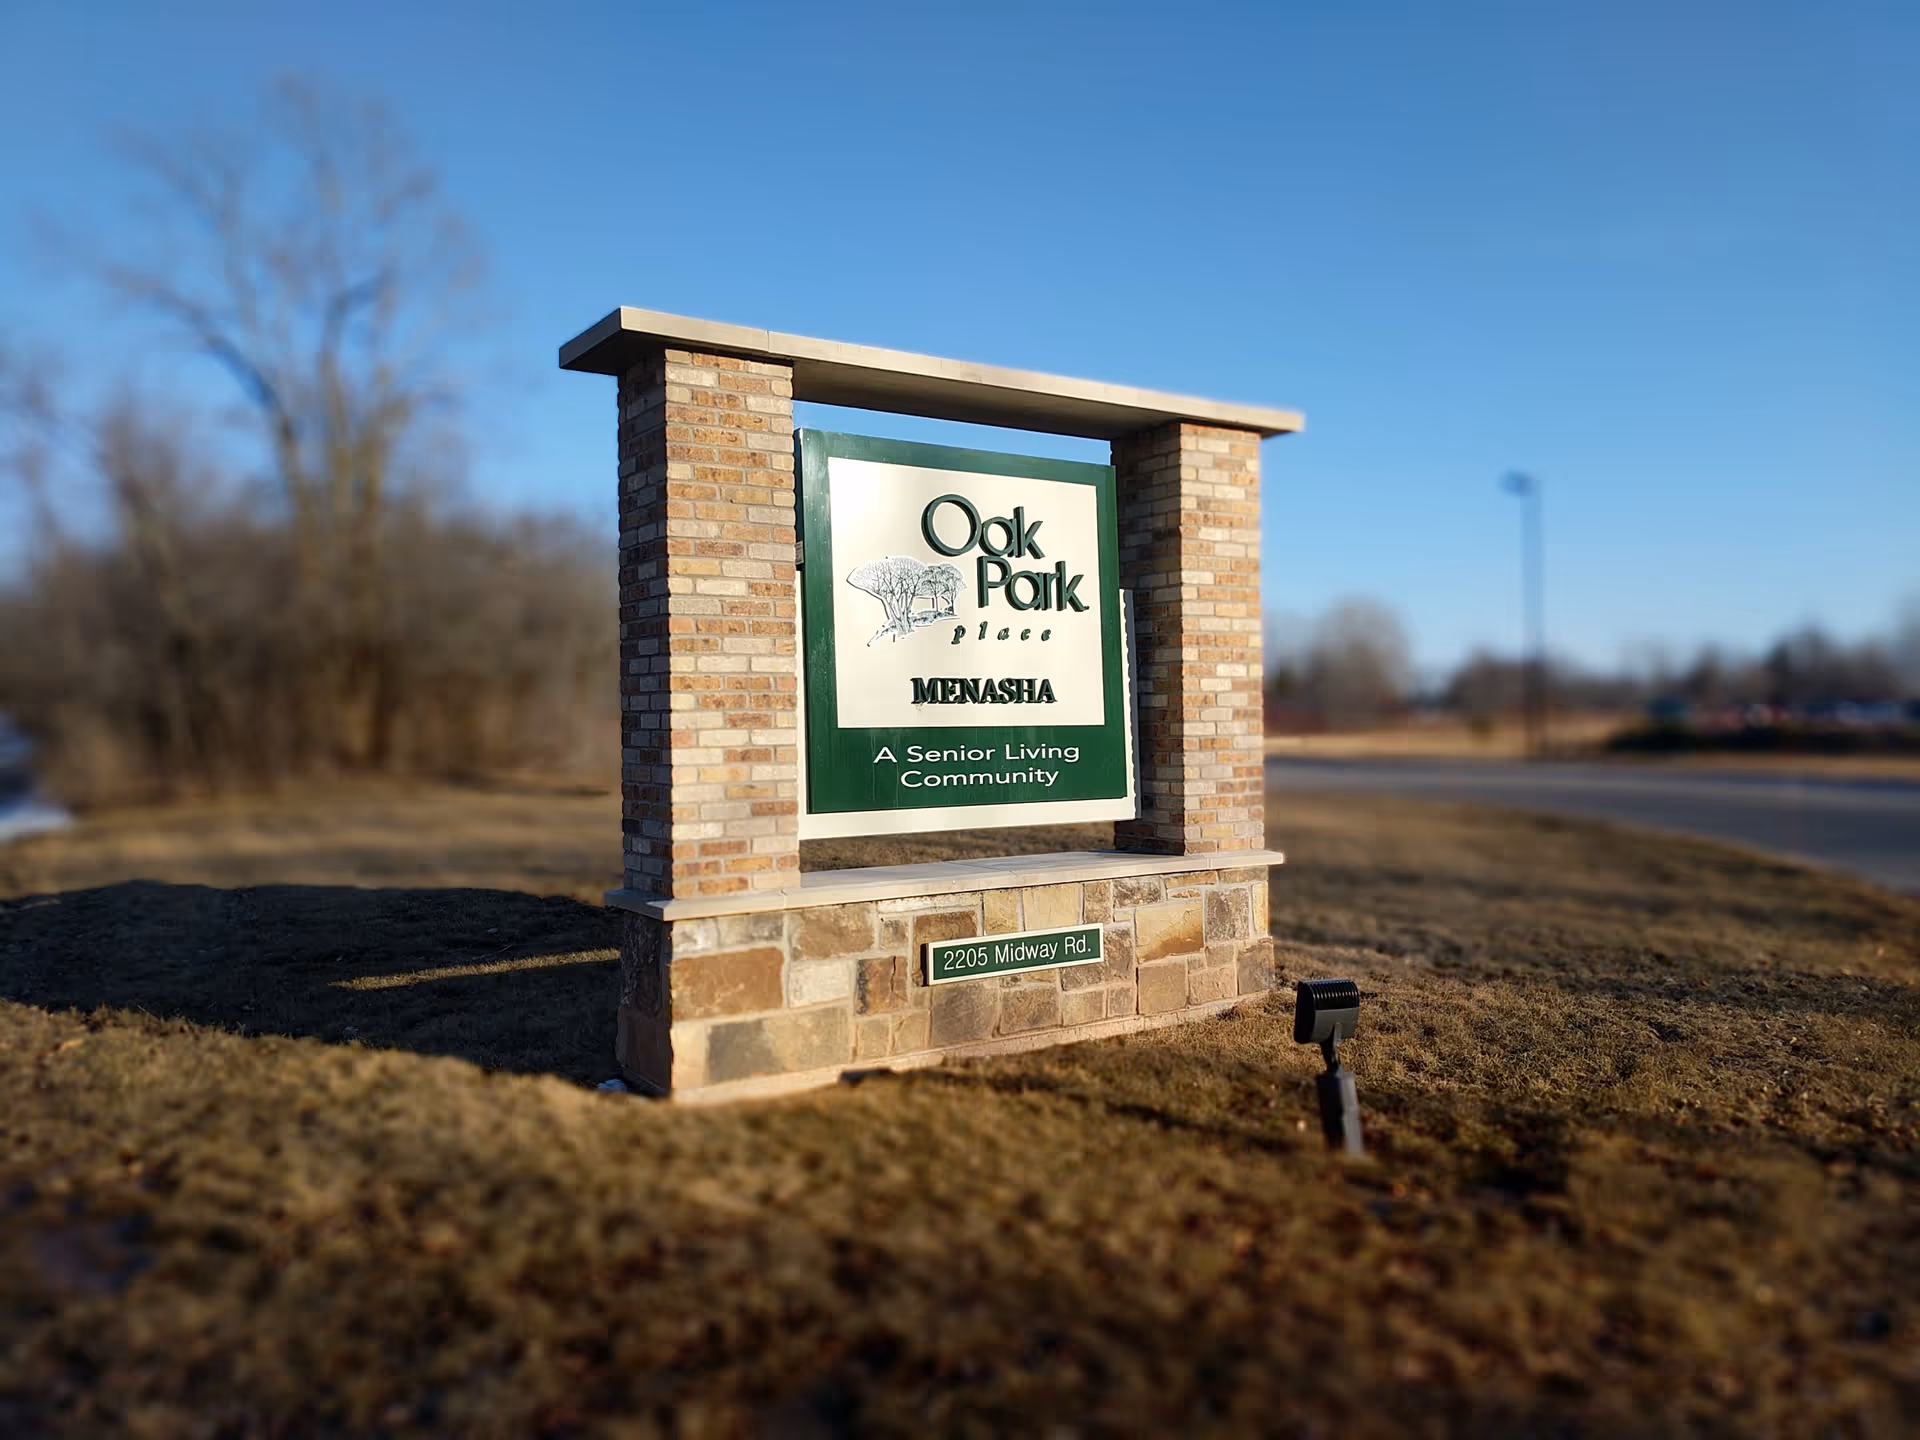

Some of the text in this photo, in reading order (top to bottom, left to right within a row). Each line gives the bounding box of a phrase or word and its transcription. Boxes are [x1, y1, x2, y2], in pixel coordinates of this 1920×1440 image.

[921, 494, 1045, 559] Oak
[976, 556, 1087, 612] Park
[951, 621, 1052, 645] place
[910, 677, 1057, 704] MENASHA
[873, 743, 1080, 763] A Senior Living
[900, 768, 1059, 788] Community
[943, 934, 1092, 971] 2205 Midway Rd.
